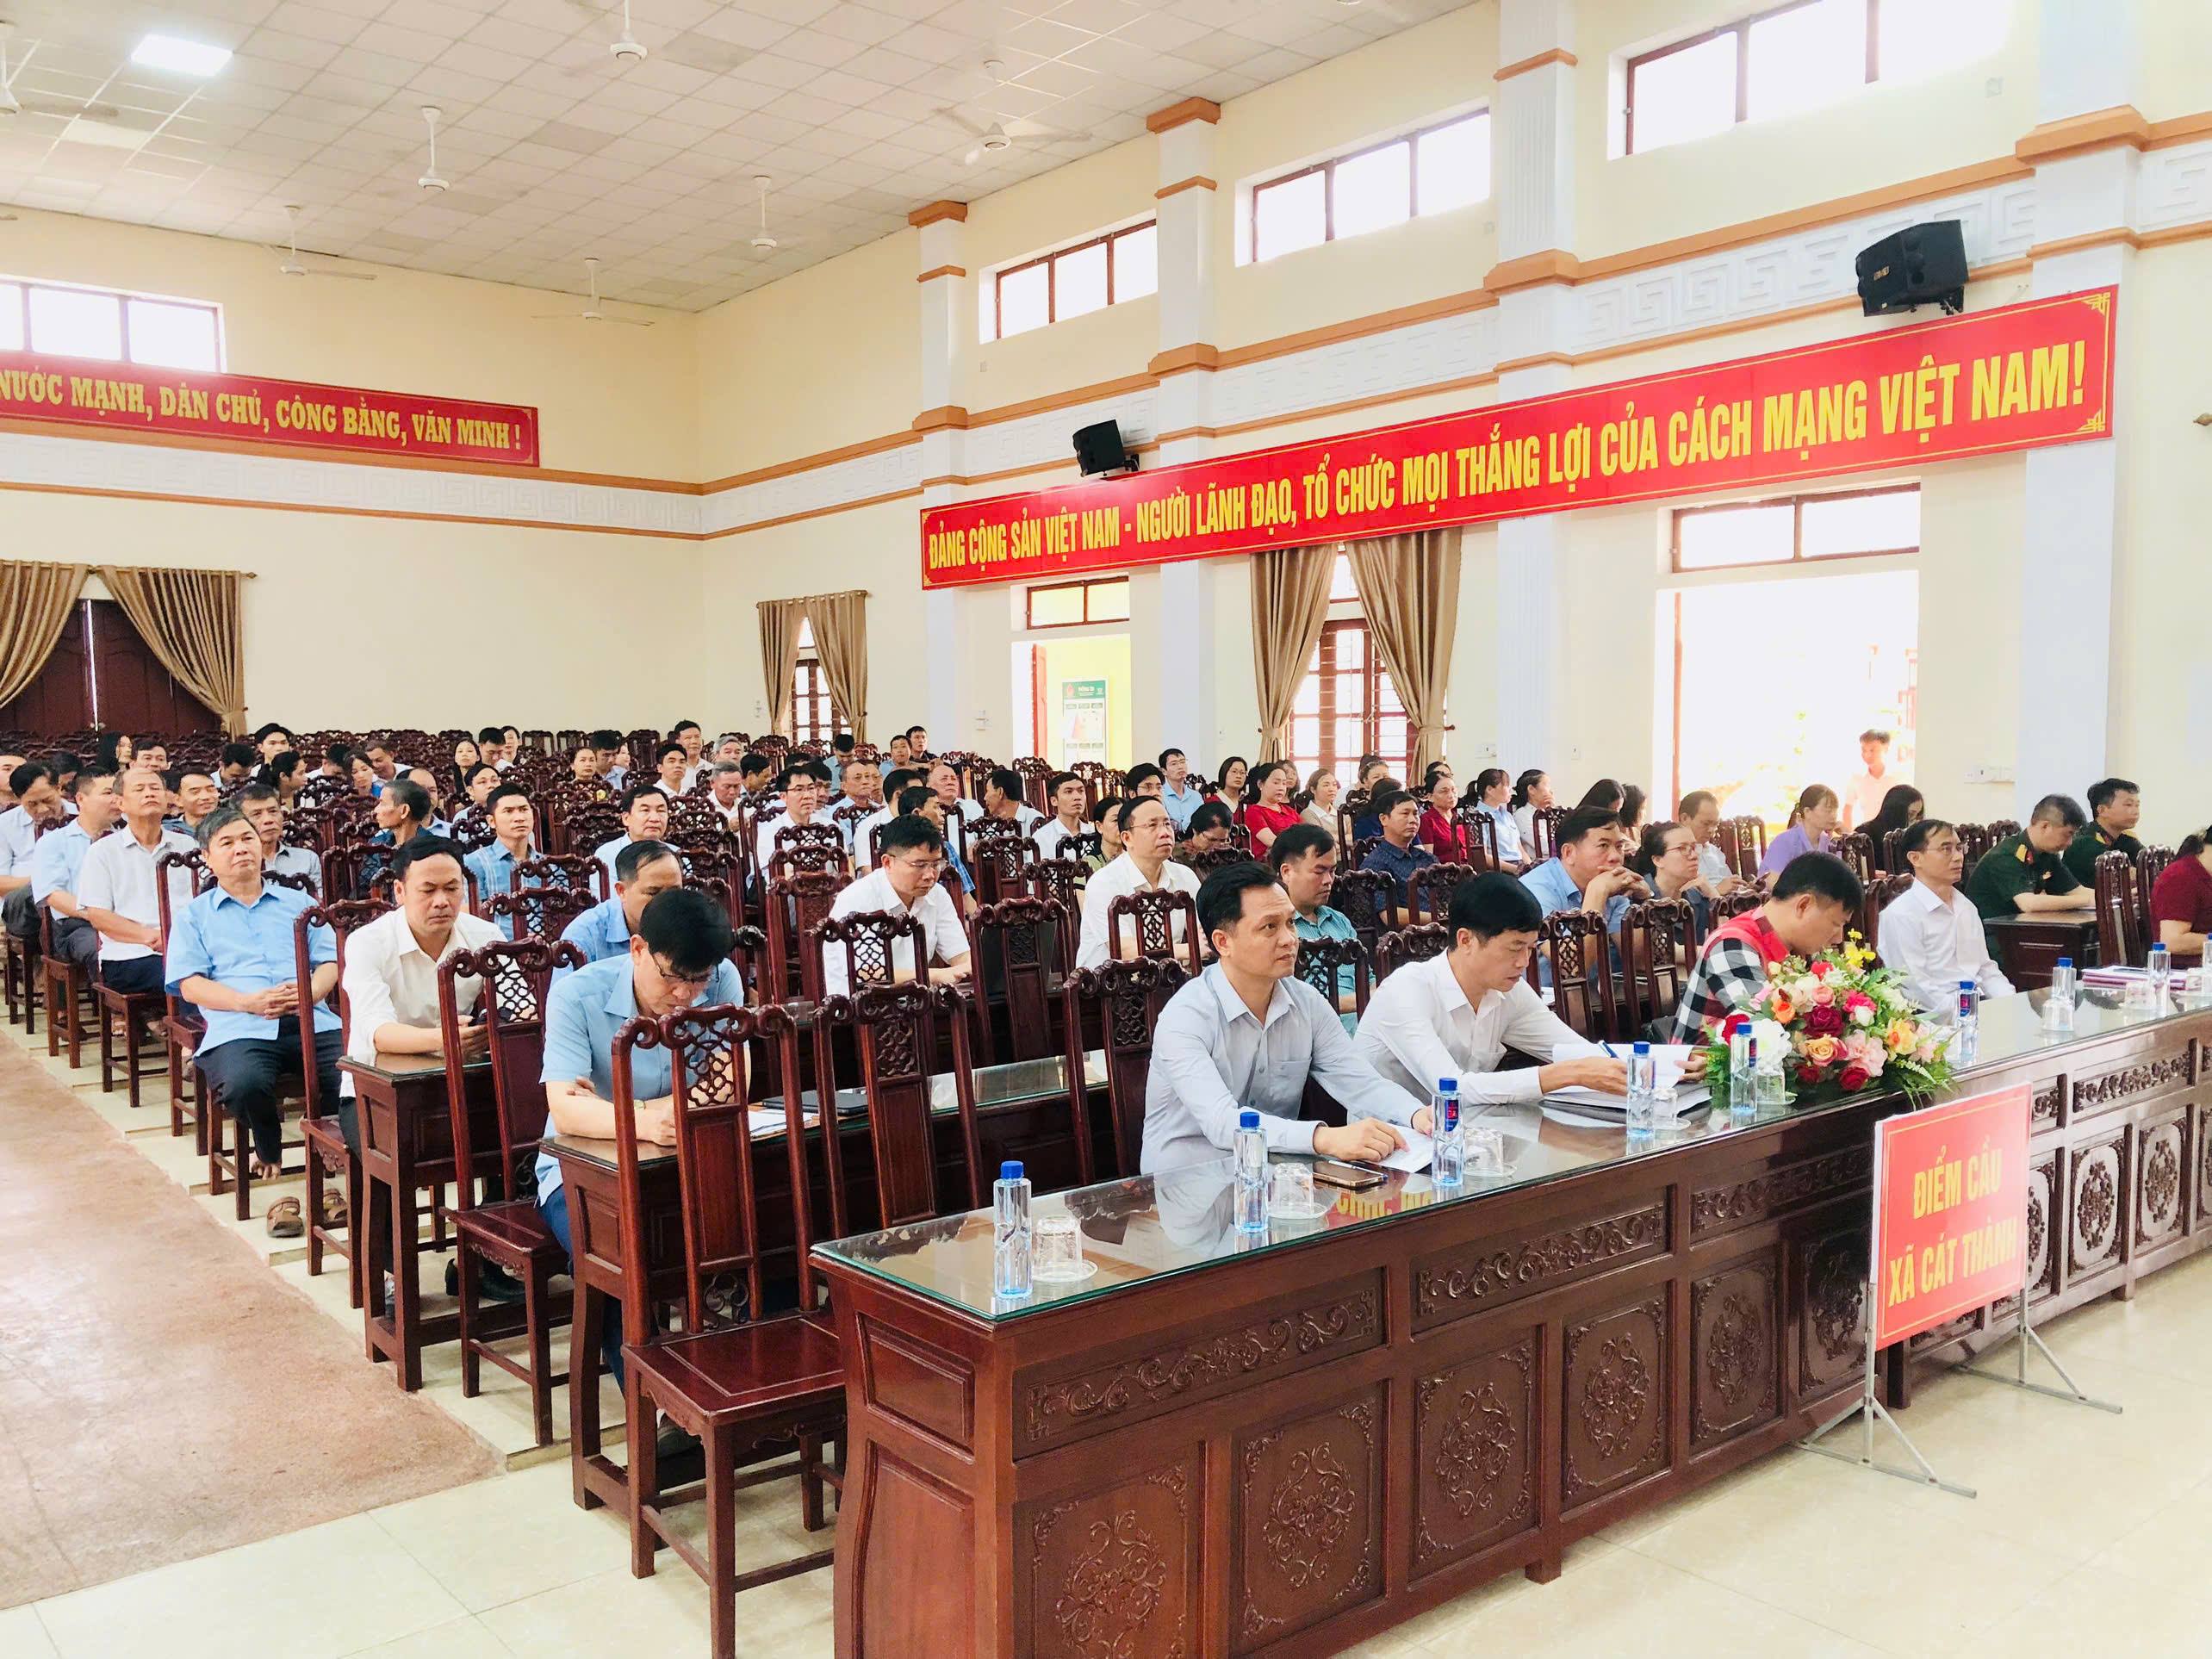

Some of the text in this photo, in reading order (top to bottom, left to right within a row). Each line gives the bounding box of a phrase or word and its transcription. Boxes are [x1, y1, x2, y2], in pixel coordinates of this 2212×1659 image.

[70, 376, 153, 421] MẠNH,
[159, 382, 208, 420] DÂN
[216, 388, 270, 433] CHỦ,
[276, 395, 337, 433] CÔNG
[343, 396, 407, 447] BẰNG,
[411, 409, 451, 444] VĂN
[929, 339, 2085, 571] ĐẢNG CỘNG SẢN VIỆT NAM - NGƯỜI LÃNH ĐẠO, TỔ CHỨC MỌI THẮNG LỢI CỦA CÁCH MẠNG VIỆT NAM!
[1912, 1134, 2004, 1220] ĐIỂM CẦU
[1888, 1244, 1916, 1308] XÃ
[1921, 1233, 1959, 1295] CÁT
